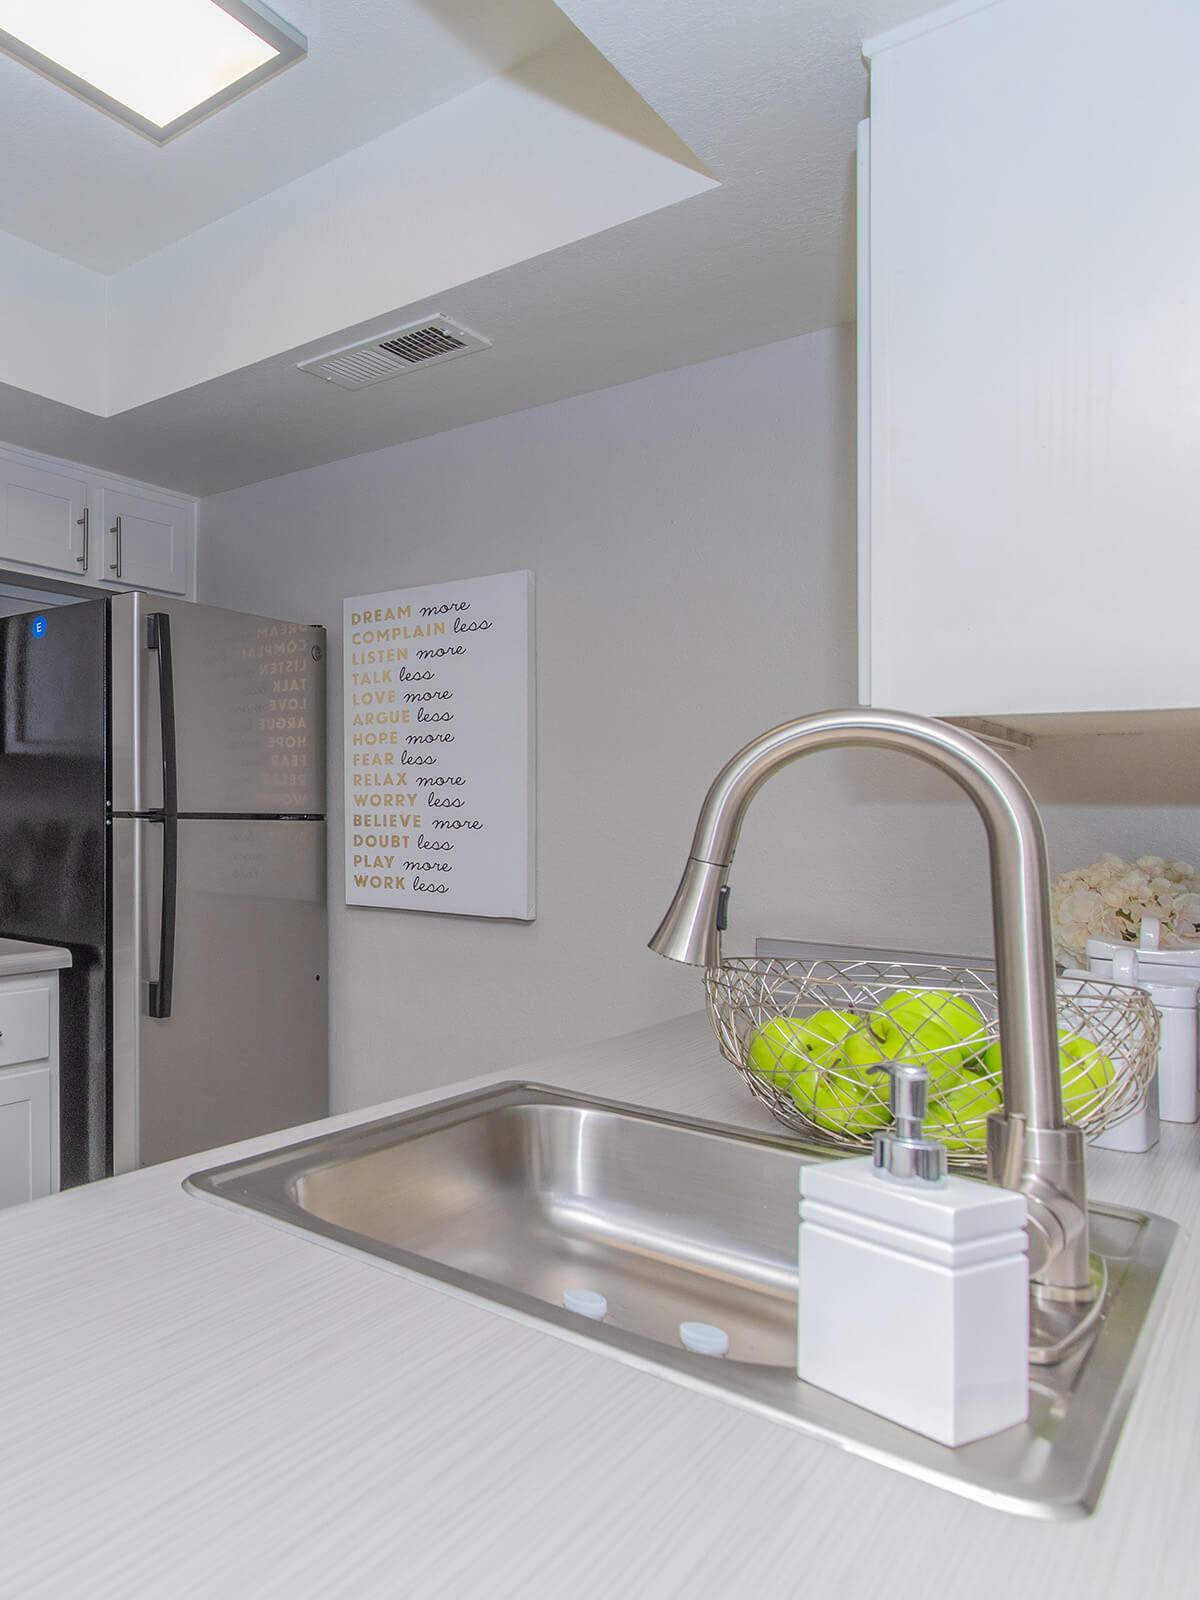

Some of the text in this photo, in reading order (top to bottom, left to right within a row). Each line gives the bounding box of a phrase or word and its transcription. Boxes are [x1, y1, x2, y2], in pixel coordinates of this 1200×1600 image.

[352, 601, 471, 624] DREAM more
[36, 622, 42, 632] E
[352, 618, 492, 644] COMPLAIN less
[352, 646, 467, 665] LISTEN more
[352, 667, 434, 685] TALK less
[352, 689, 453, 705] LOVE more
[353, 708, 454, 725] ARGUE less
[353, 732, 455, 746] HOPE more
[353, 750, 437, 766] FEAR less
[353, 773, 466, 786] RELAX more
[354, 792, 464, 807] WORRY less
[354, 815, 483, 830] BELIEVE more
[354, 835, 454, 850] DOUBT less
[354, 855, 452, 872] PLAY more
[354, 875, 449, 893] WORK less
